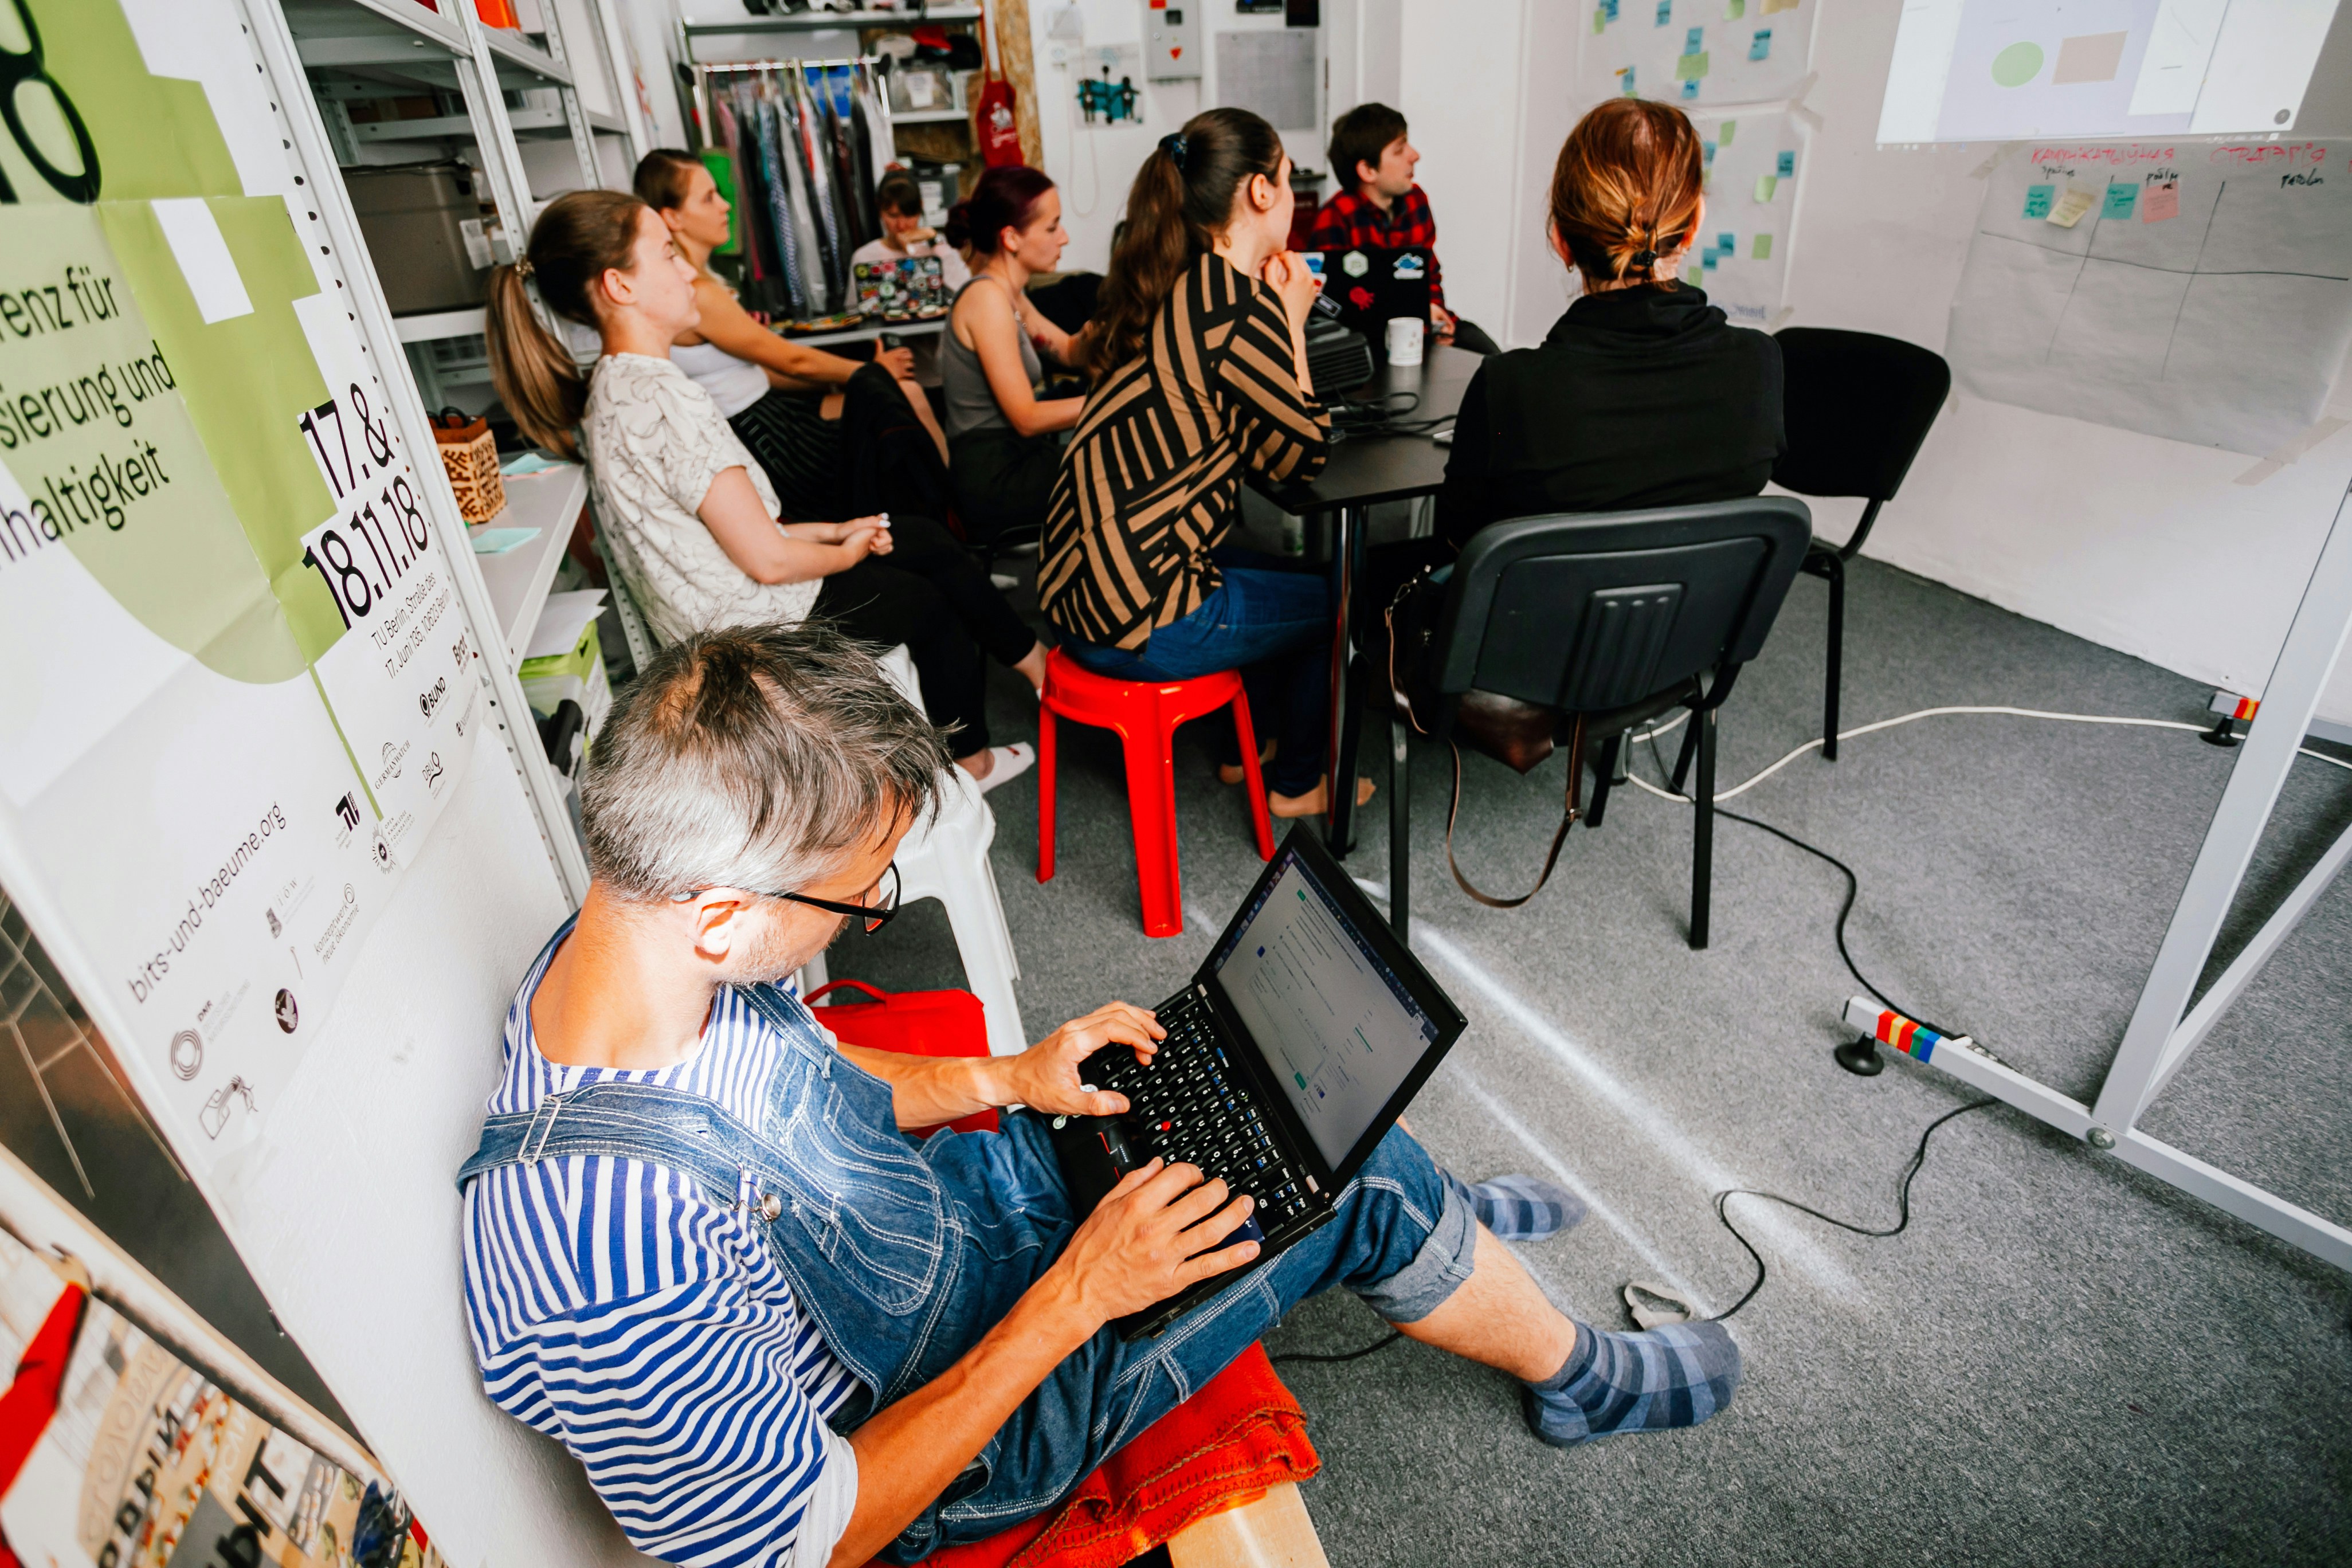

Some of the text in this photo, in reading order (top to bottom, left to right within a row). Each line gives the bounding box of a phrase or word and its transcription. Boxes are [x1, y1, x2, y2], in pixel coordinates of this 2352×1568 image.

[0, 0, 102, 205] 8
[0, 266, 119, 342] enz für
[118, 339, 177, 401] und
[300, 383, 395, 499] 17. &
[302, 476, 428, 630] 18.11.18
[371, 572, 436, 650] TU Berlin, Straße des
[385, 587, 452, 679] 17. Juni 135, 10623 Berlin
[452, 632, 468, 667] Brot
[428, 677, 446, 708] BUND
[374, 740, 411, 790] GERMANWATCH
[422, 761, 435, 781] DBU
[384, 817, 395, 830] OPEN
[387, 809, 407, 836] KNOWLEDGE
[390, 813, 413, 842] FOUNDATION
[128, 801, 287, 1004] bits-und-baeume.org
[314, 901, 349, 955] konzeptwerk
[322, 903, 360, 965] neue ökonomie
[205, 1436, 287, 1568] ЫТ
